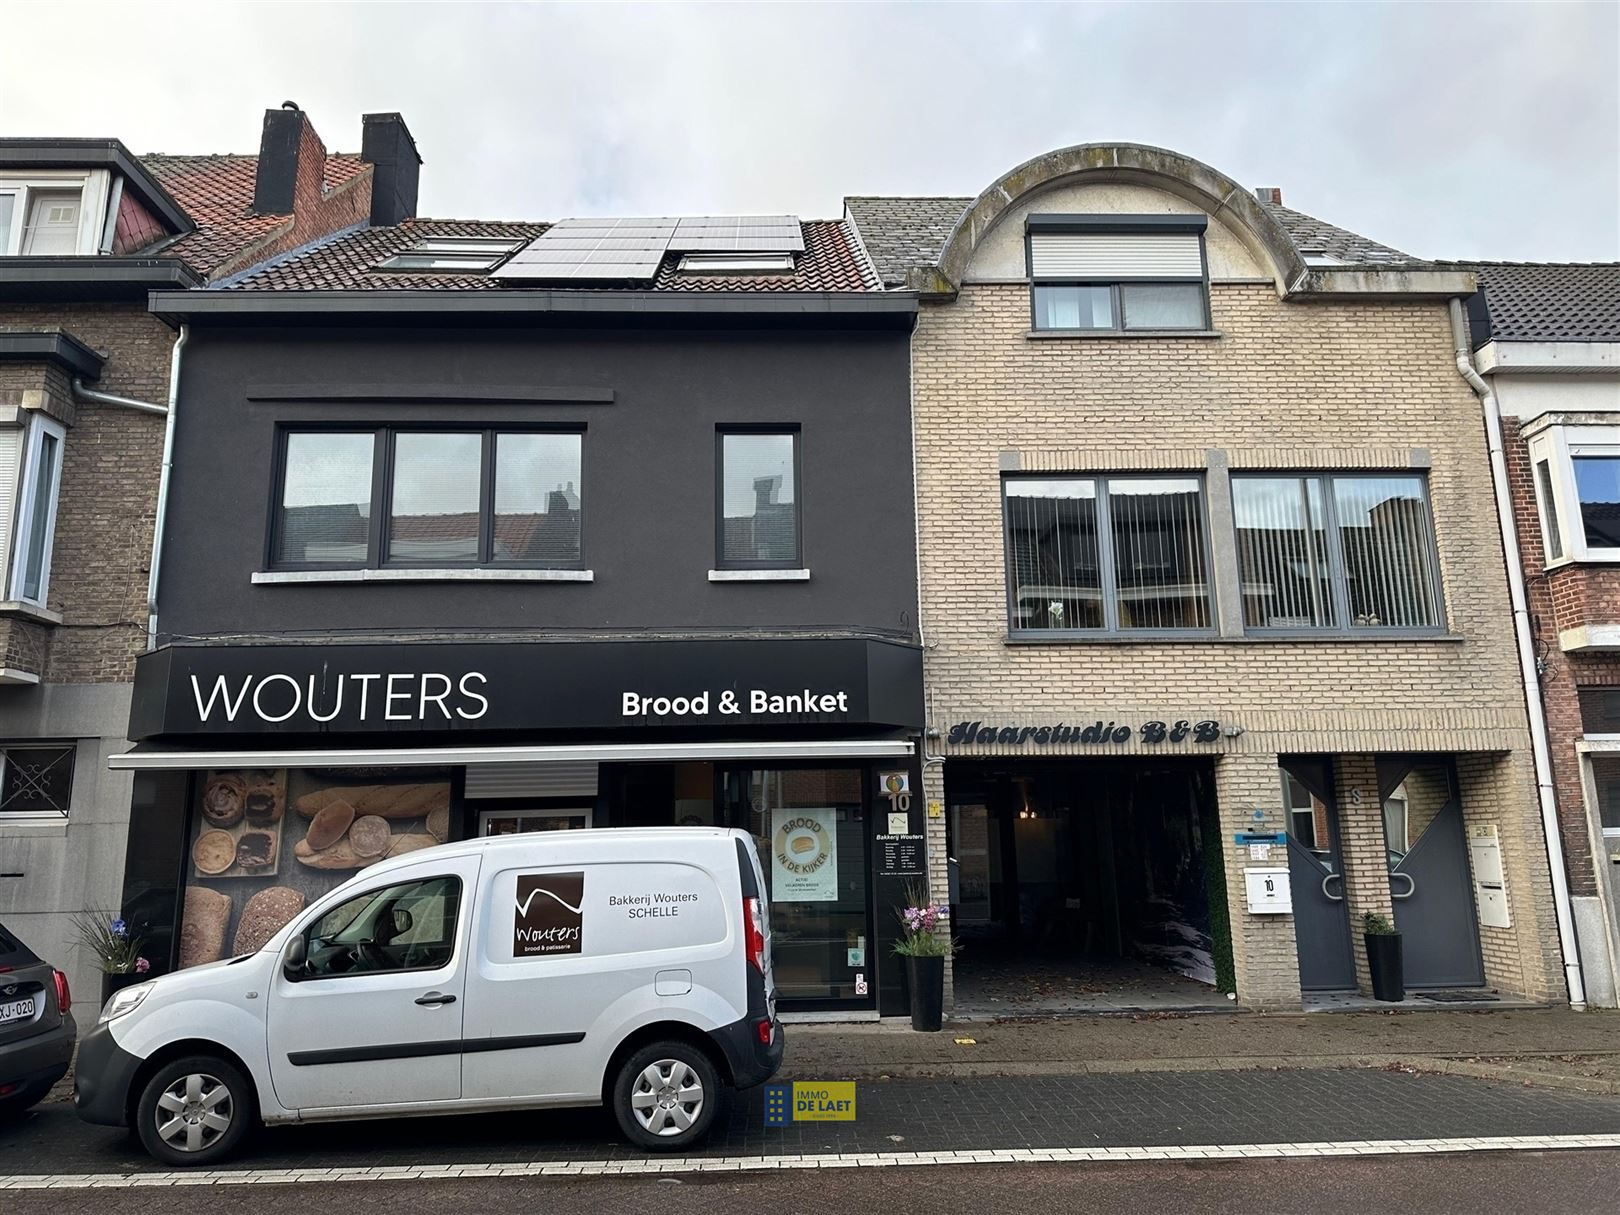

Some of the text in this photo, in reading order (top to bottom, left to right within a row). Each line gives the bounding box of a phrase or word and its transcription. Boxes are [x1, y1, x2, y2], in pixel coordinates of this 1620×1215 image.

[190, 672, 489, 722] WOUTERS
[622, 689, 848, 716] Brood & Banket
[947, 720, 1132, 744] Haarstudio
[889, 793, 910, 811] 10
[782, 817, 822, 834] BROOD
[777, 853, 788, 865] IN
[787, 862, 799, 873] DE
[802, 852, 828, 873] KIJKER
[1264, 879, 1274, 892] 10
[609, 893, 698, 906] Bakkerij Wouters
[628, 906, 678, 919] SCHELLE
[516, 926, 580, 942] Wouters
